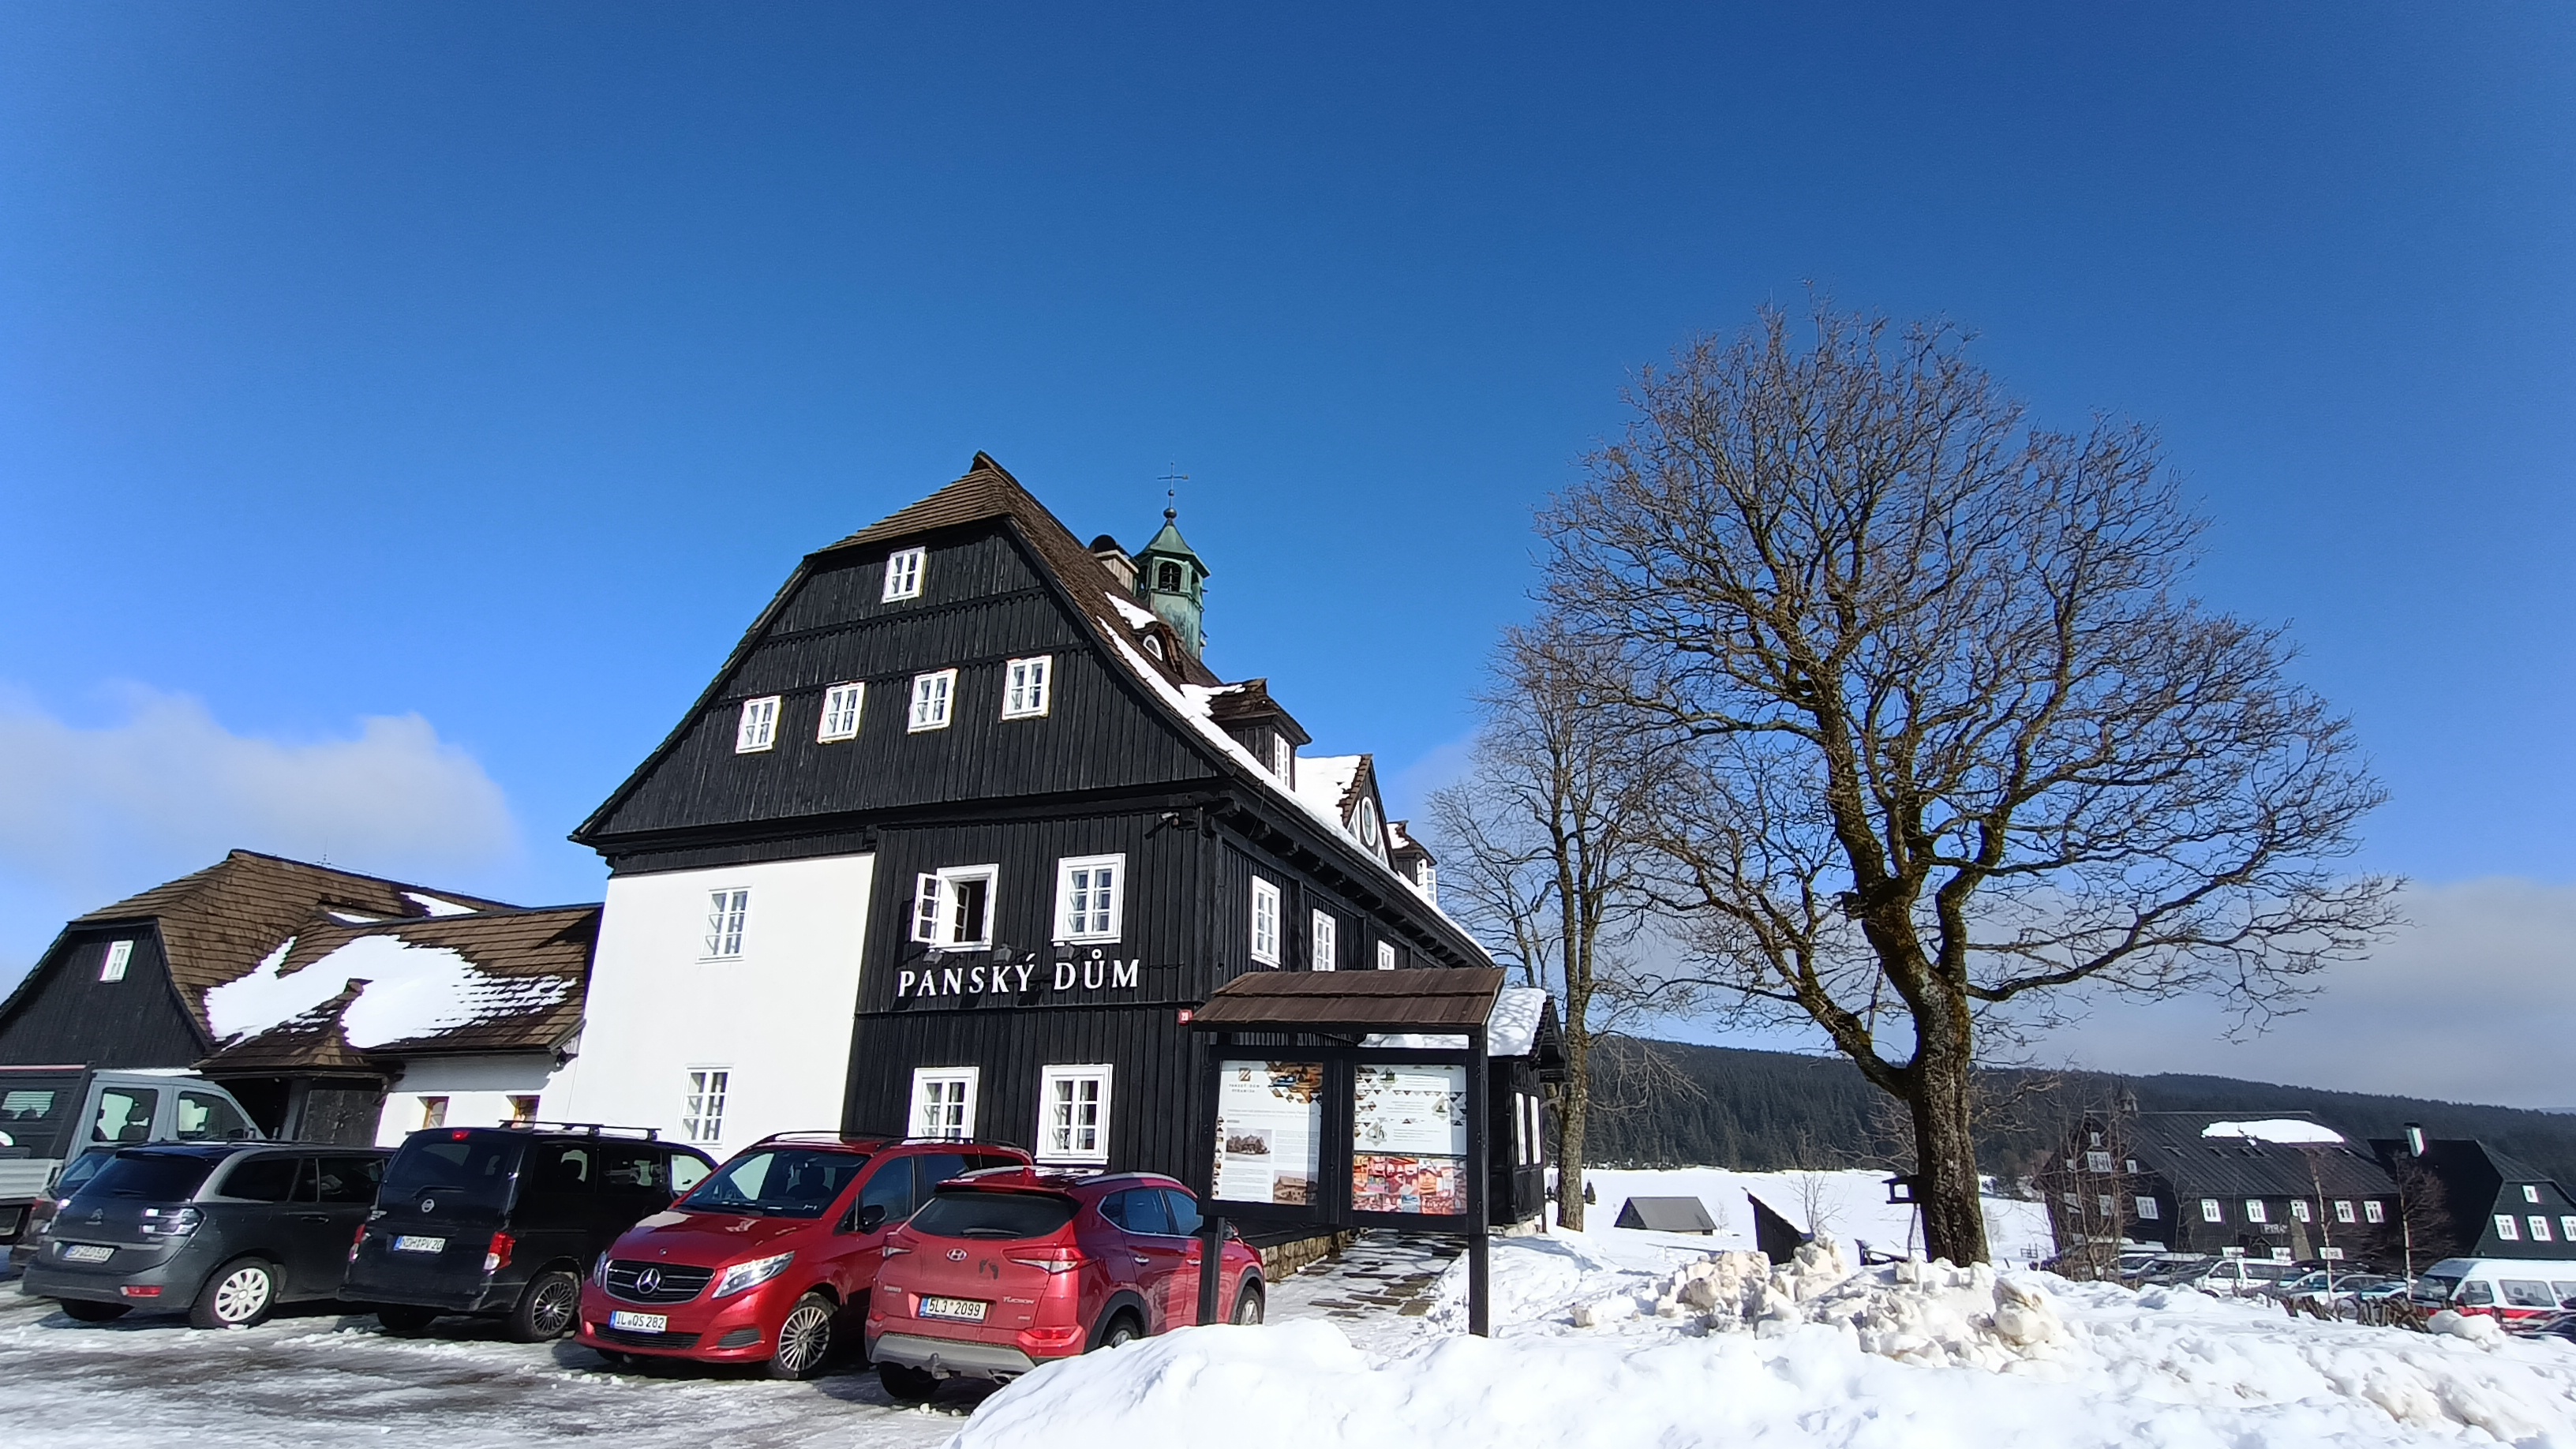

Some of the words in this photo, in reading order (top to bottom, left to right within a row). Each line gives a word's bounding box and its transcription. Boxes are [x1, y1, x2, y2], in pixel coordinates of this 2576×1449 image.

[897, 953, 1035, 998] PANSKÝ
[1054, 949, 1140, 990] DŮM
[928, 1298, 948, 1313] 5L3
[954, 1301, 981, 1316] 2099
[616, 1312, 626, 1325] IL
[646, 1316, 665, 1329] 282
